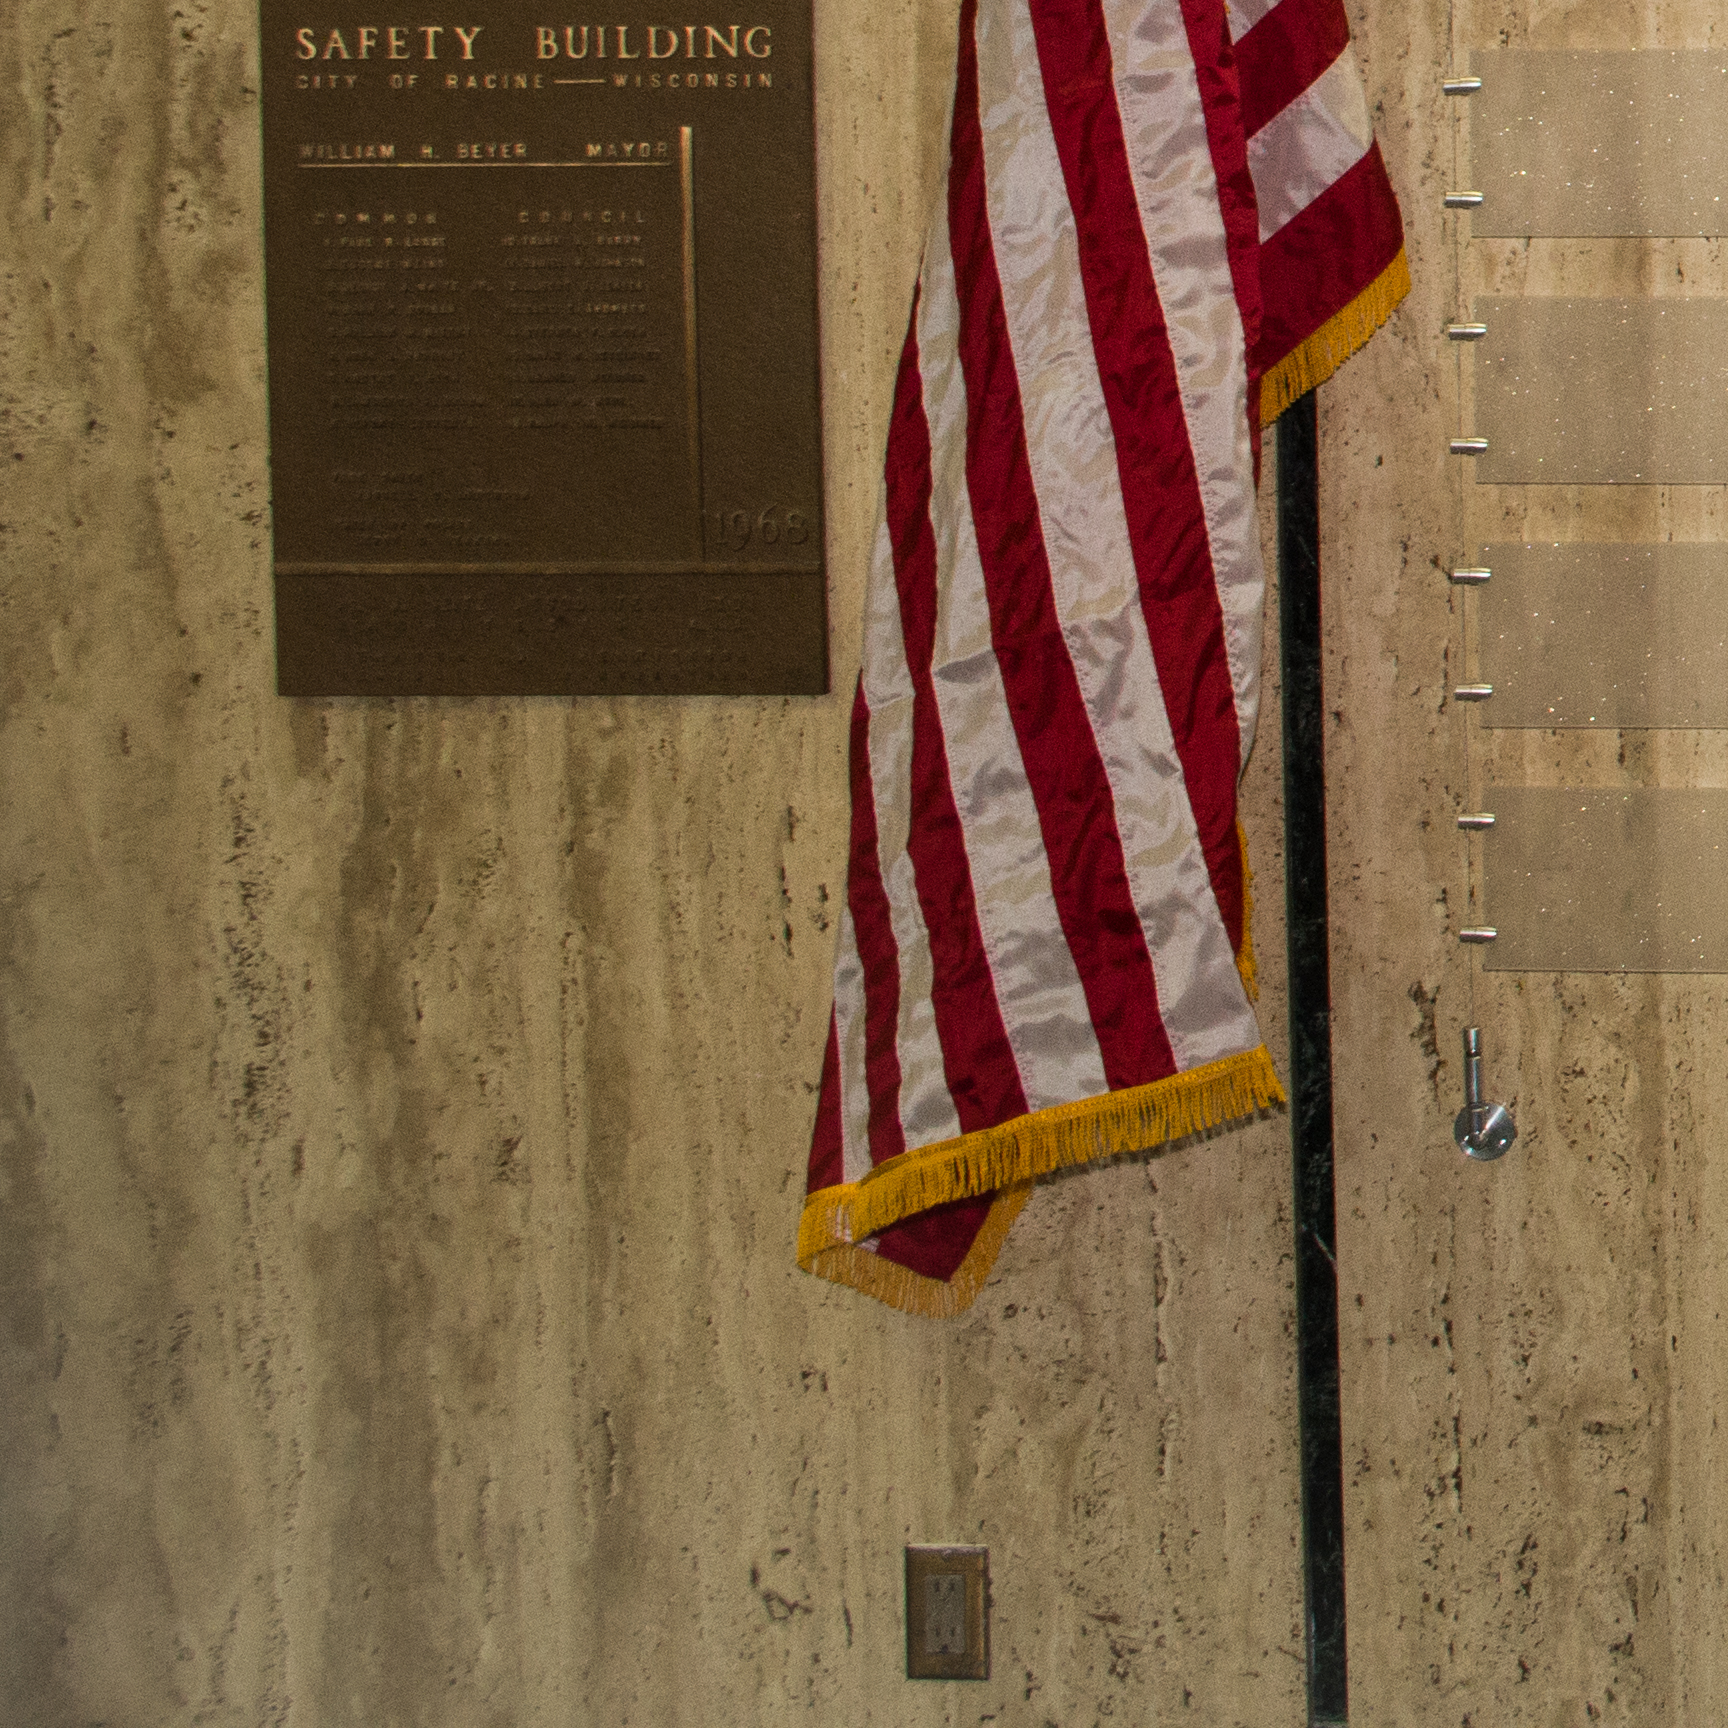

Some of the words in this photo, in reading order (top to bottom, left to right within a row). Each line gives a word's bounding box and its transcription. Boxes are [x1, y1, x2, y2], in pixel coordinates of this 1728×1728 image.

[296, 26, 484, 60] SAFETY
[536, 25, 772, 59] BUILDING
[298, 74, 358, 89] CITY
[389, 73, 419, 89] OF
[445, 73, 544, 89] RACINE
[613, 73, 773, 88] WISCONSIN
[586, 142, 668, 158] MAYOR
[712, 504, 810, 553] 1968
